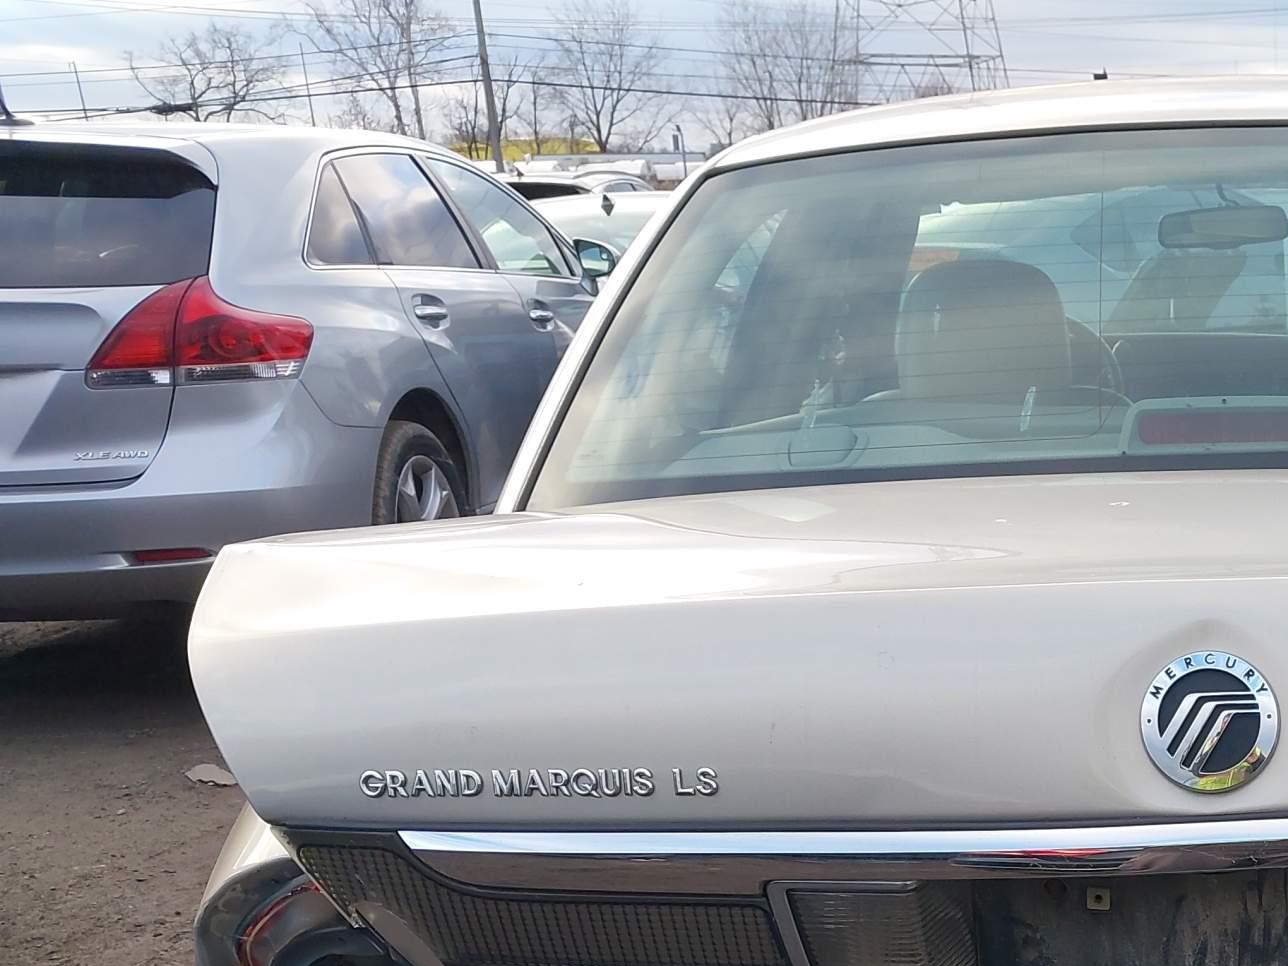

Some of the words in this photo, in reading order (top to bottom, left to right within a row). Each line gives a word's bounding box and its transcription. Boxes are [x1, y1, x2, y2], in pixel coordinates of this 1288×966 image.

[74, 451, 111, 461] XLE
[112, 449, 149, 460] AWD
[1149, 653, 1268, 698] MERCURY
[359, 768, 484, 798] GRAND
[491, 767, 656, 799] MARQUIS
[673, 767, 720, 797] LS
